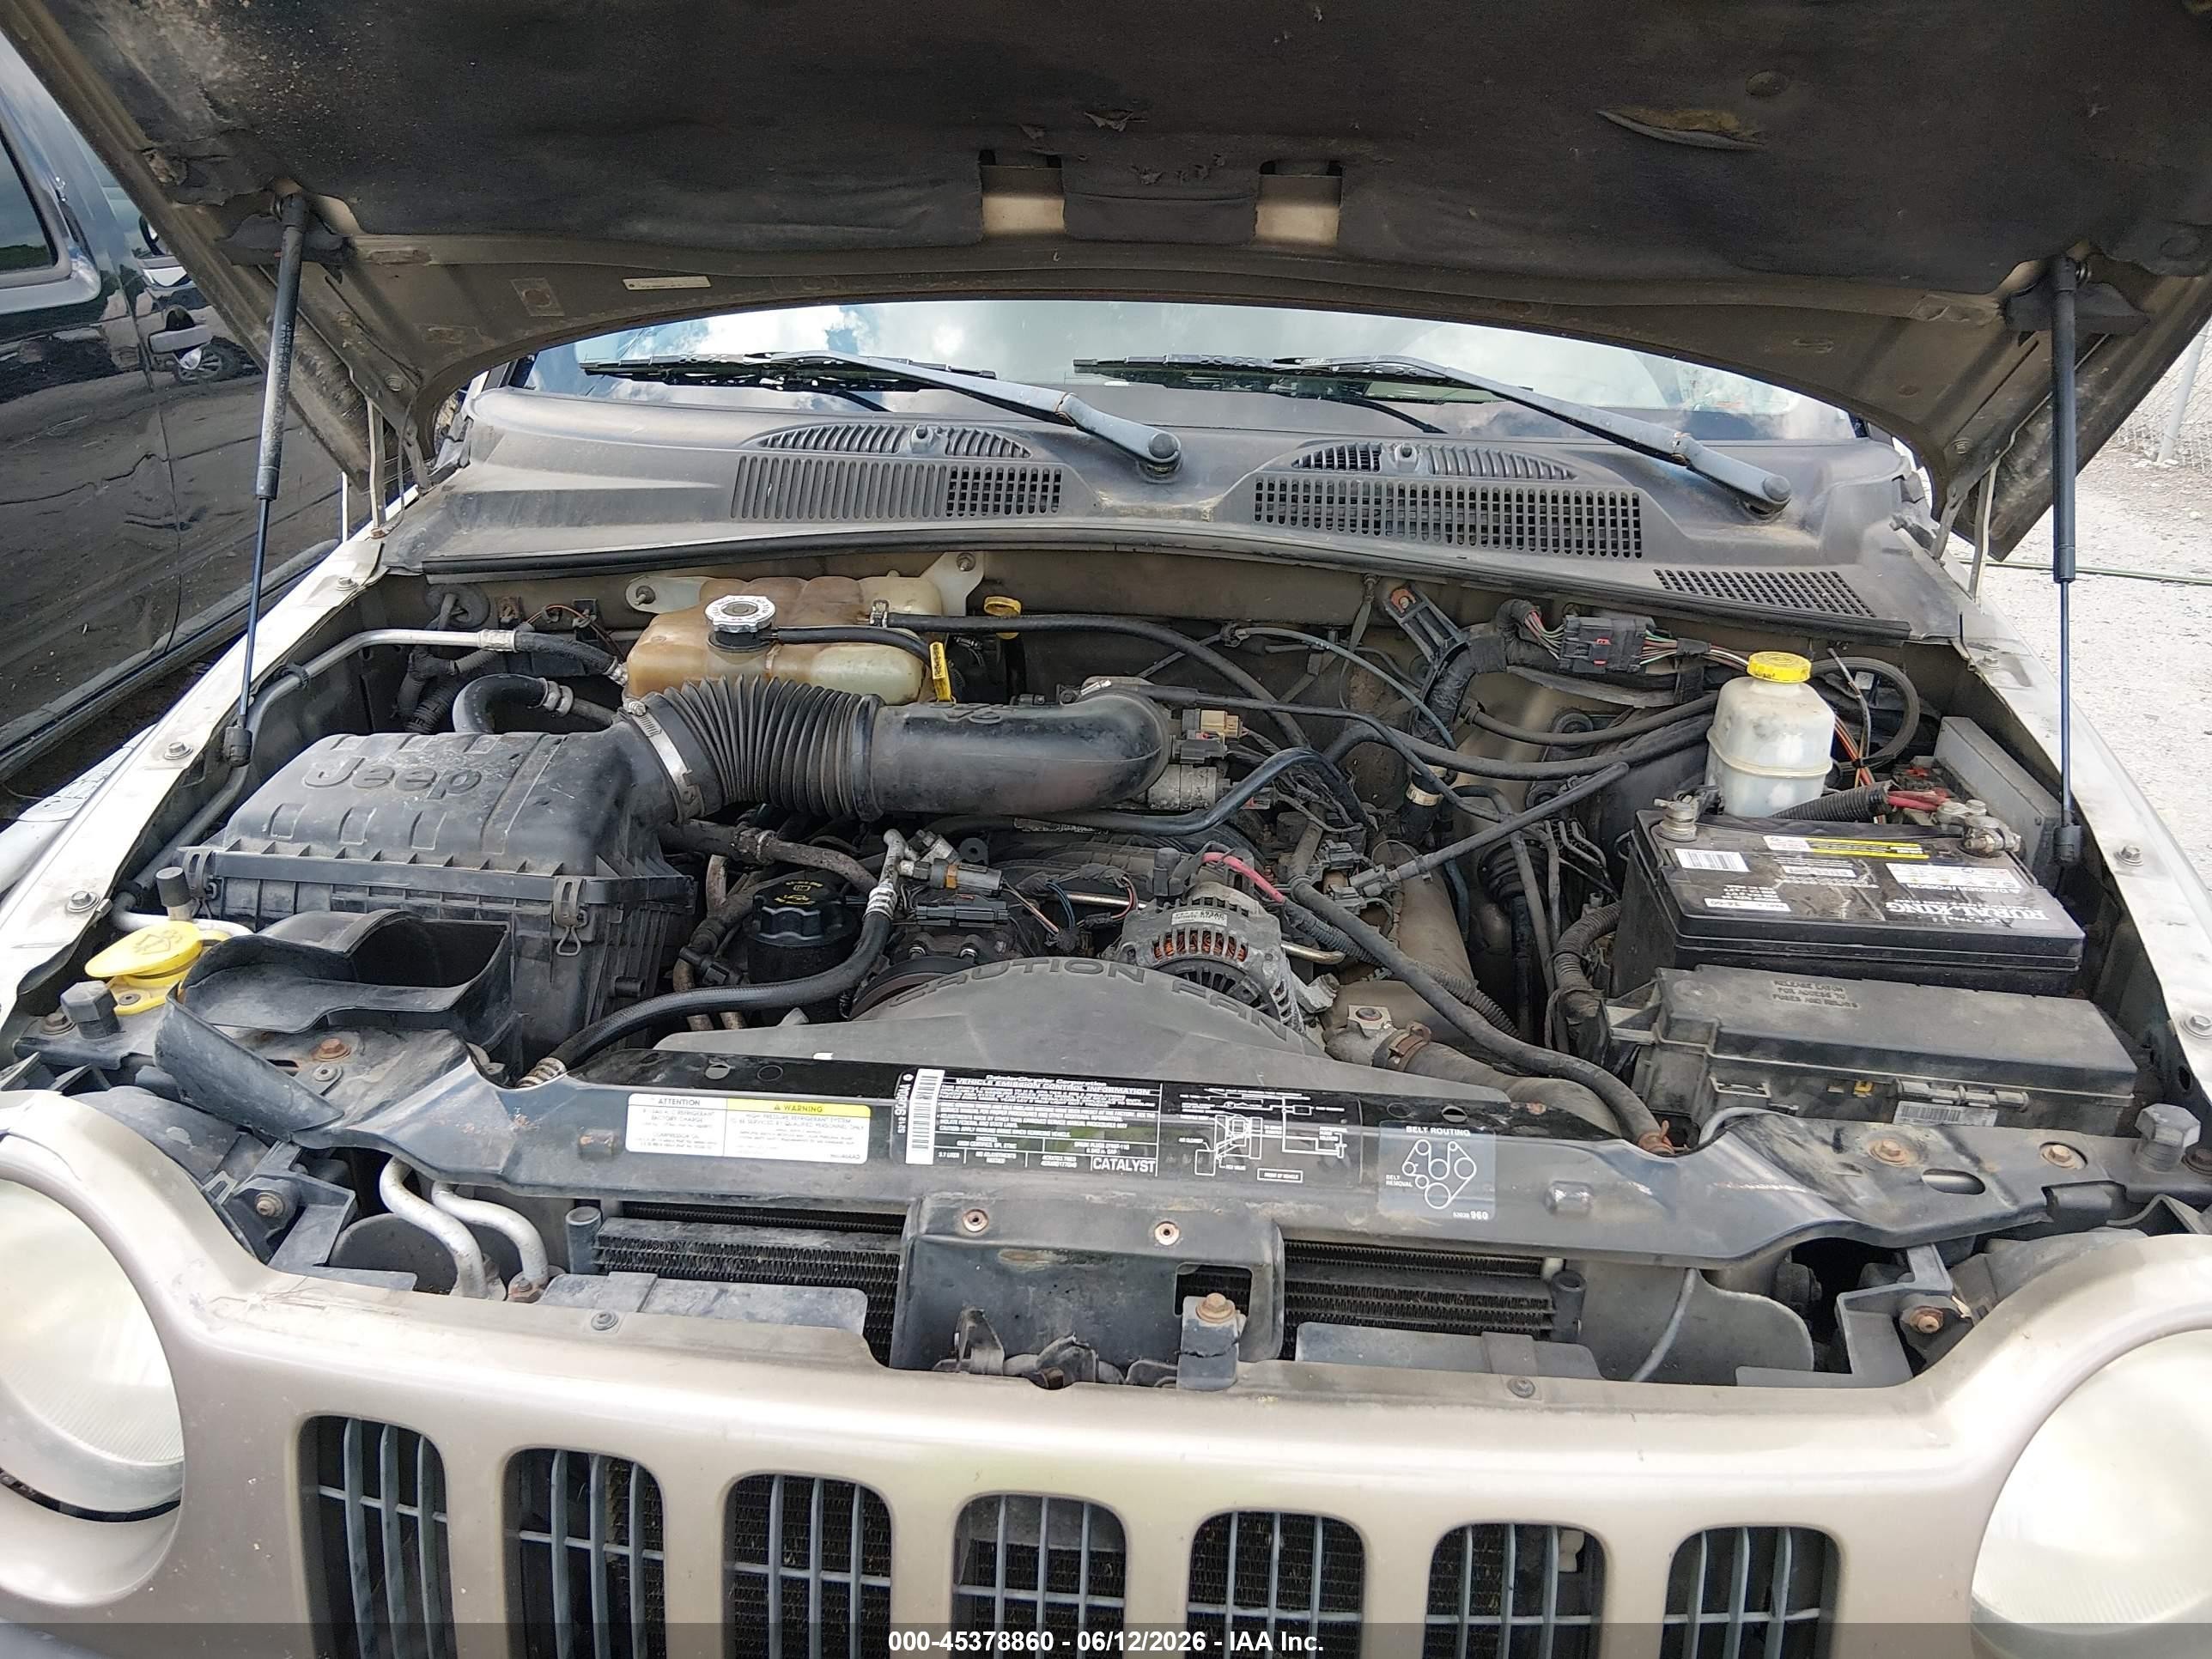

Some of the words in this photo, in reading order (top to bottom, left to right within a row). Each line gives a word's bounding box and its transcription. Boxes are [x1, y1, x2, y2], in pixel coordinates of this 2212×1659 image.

[303, 756, 483, 799] Jeep
[1885, 901, 1954, 915] KING
[1956, 906, 2050, 921] RURAL
[1774, 980, 1813, 989] RELEASE
[1814, 983, 1844, 992] LATCH
[890, 959, 1146, 1007] CAUTION
[1171, 980, 1287, 1042] FAN
[1797, 989, 1832, 998] ACCESS
[1771, 994, 1802, 1002] FUSES
[1824, 999, 1858, 1008] RELAYS
[986, 1074, 1054, 1085] DaimlerChrysler
[995, 1080, 1042, 1089] EMISSION
[1042, 1083, 1085, 1091] CONTROL
[1086, 1086, 1151, 1095] INFORMATION
[783, 1104, 823, 1113] WARNING
[1406, 1125, 1428, 1133] BELT
[1430, 1127, 1471, 1137] ROUTING
[1092, 1158, 1156, 1173] CATALYST
